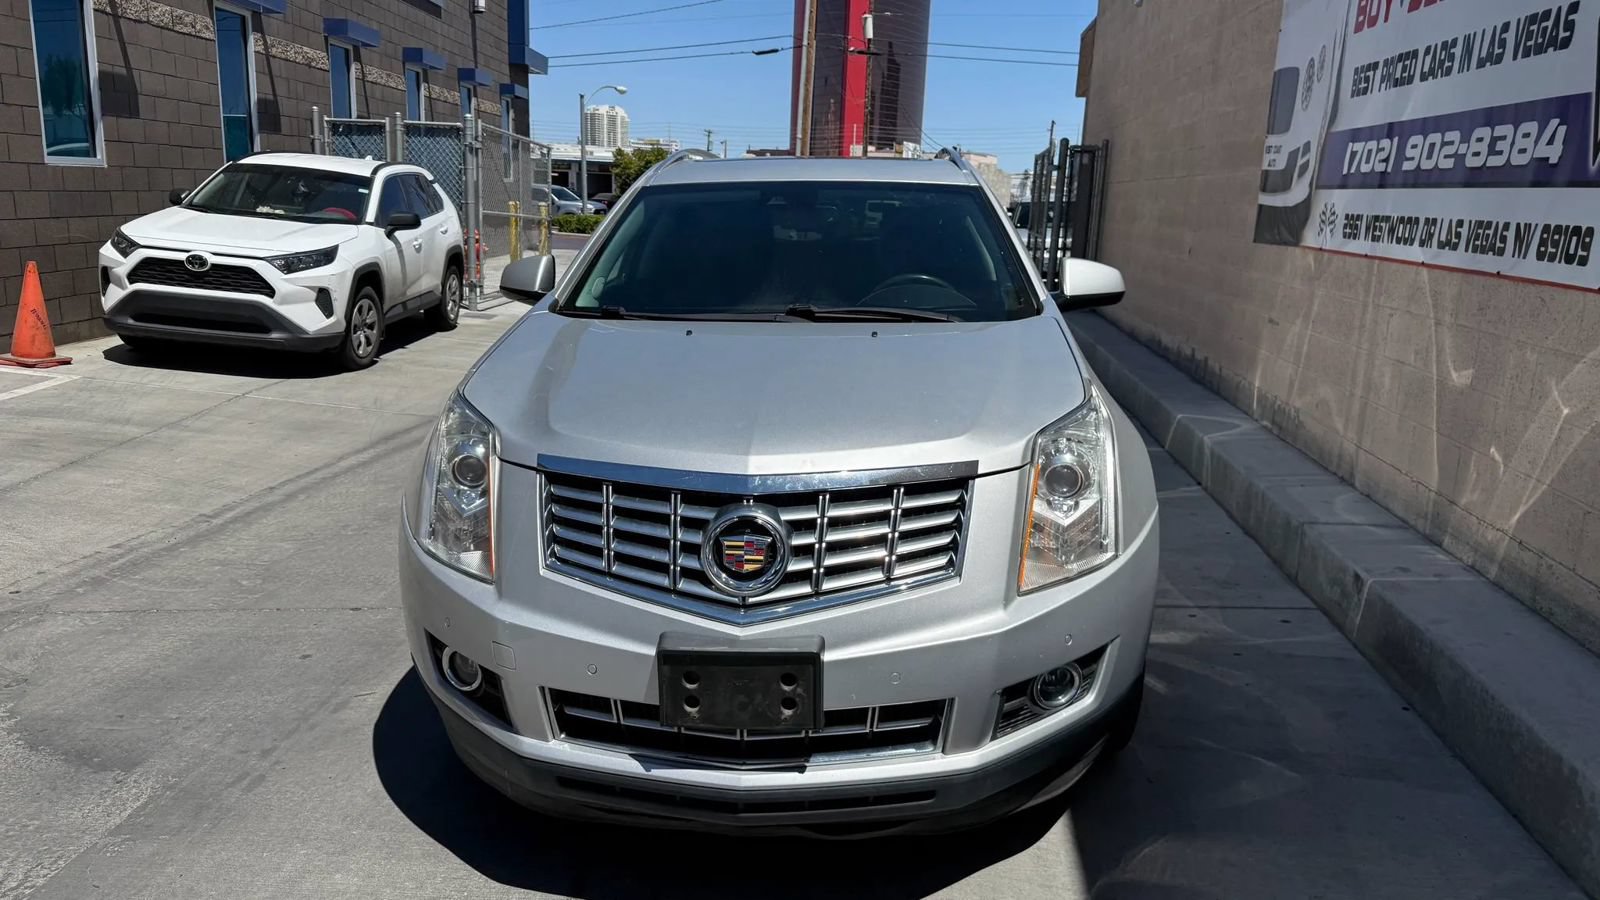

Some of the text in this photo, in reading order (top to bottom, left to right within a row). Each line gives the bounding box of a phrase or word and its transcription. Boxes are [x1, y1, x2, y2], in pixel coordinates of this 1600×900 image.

[1350, 0, 1581, 99] BEST PRICED CARS IN LAS VEGAS
[1401, 118, 1567, 171] 902-8384
[1364, 214, 1420, 247] WESTWOOD
[1418, 217, 1438, 249] DR
[1437, 217, 1464, 252] LAS
[1464, 219, 1511, 257] VEGAS
[1511, 222, 1539, 260] NV
[1535, 223, 1595, 268] 89109
